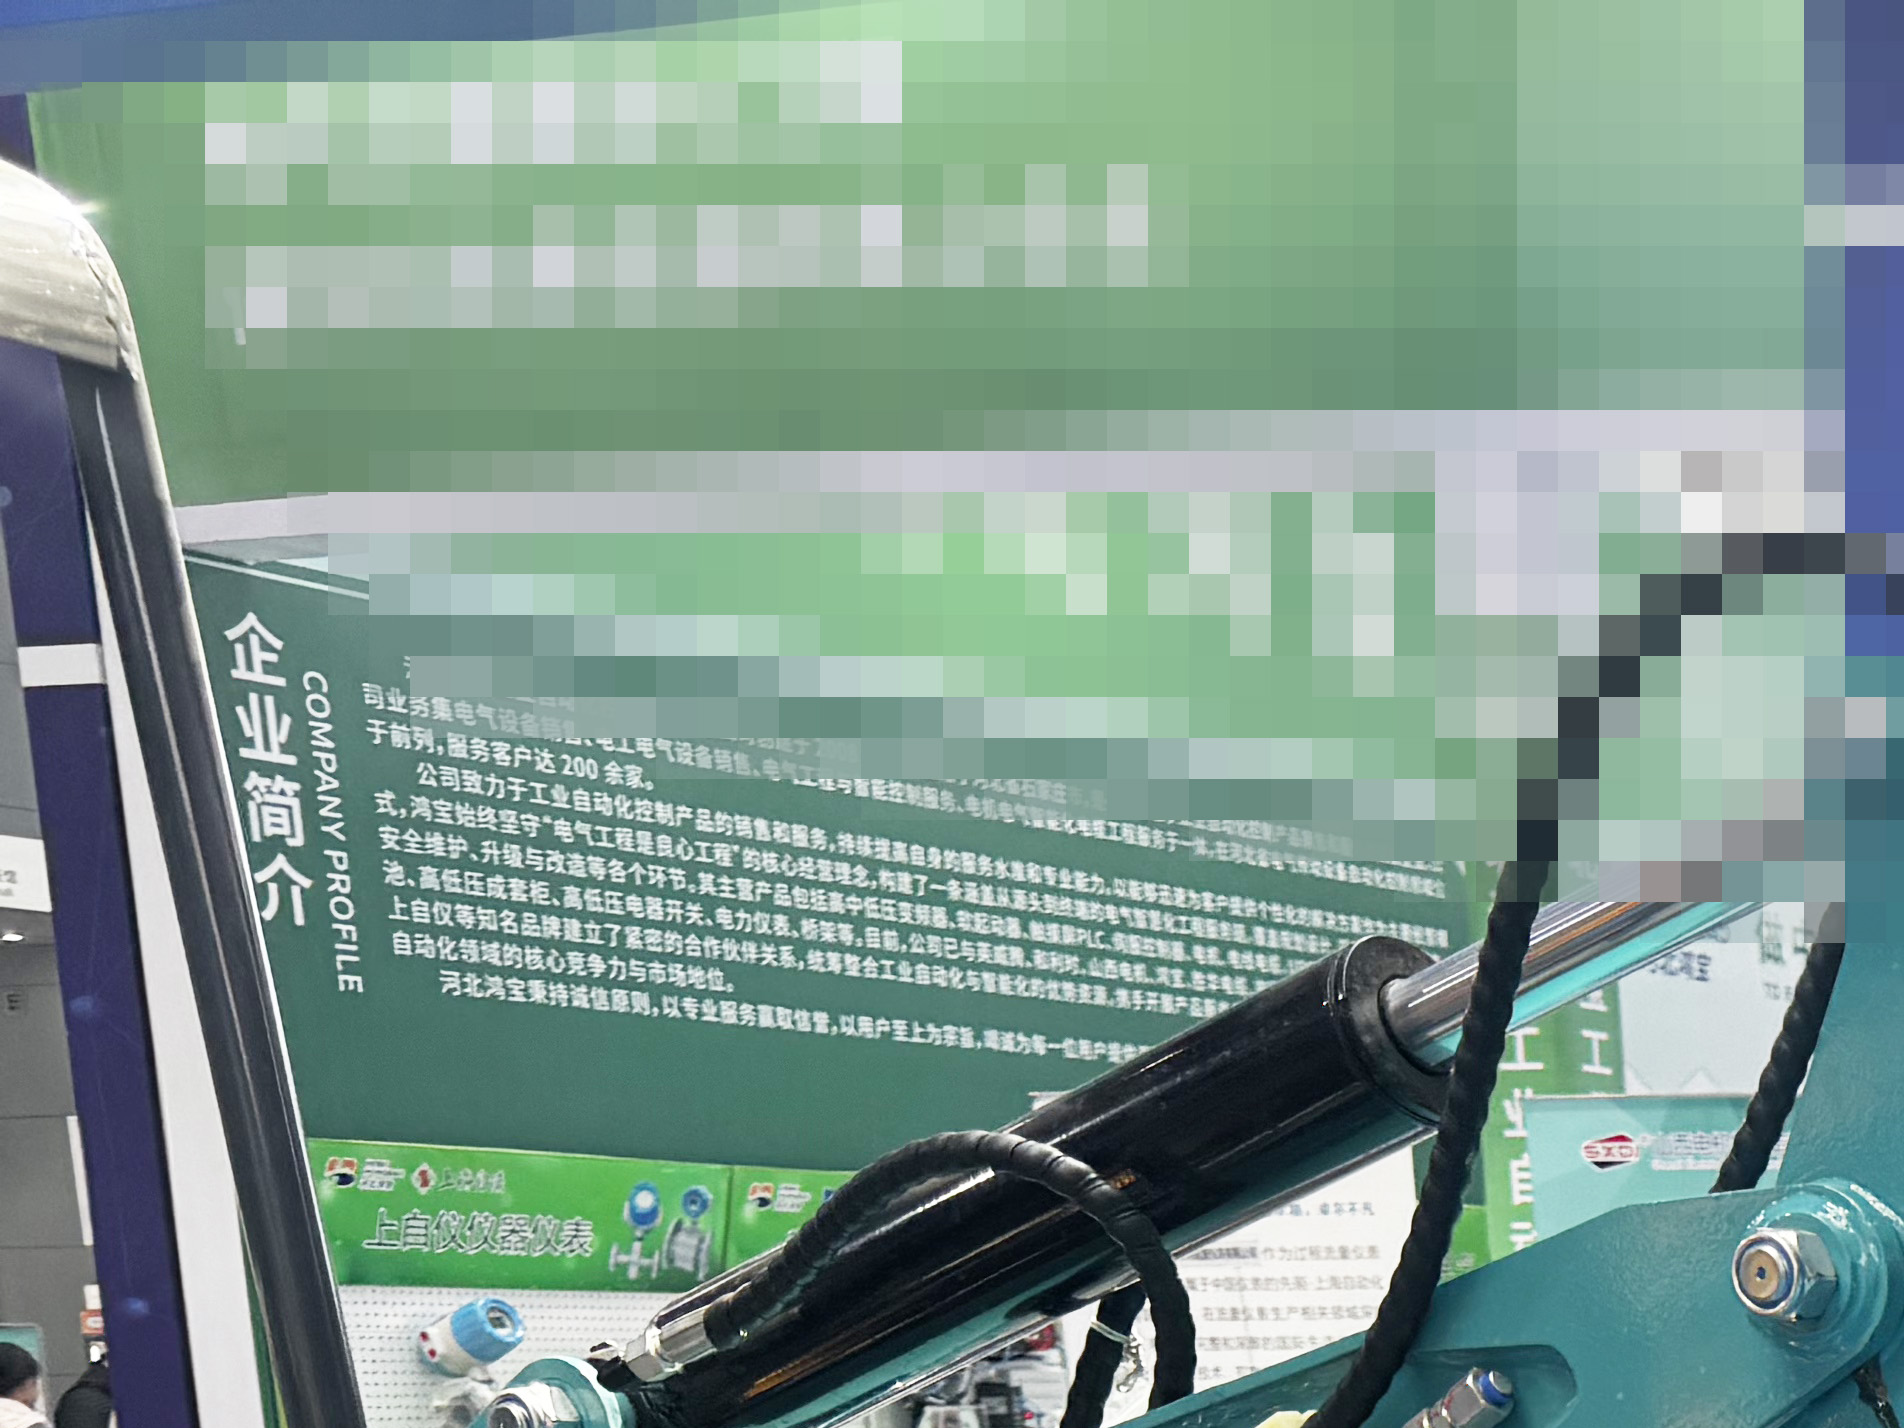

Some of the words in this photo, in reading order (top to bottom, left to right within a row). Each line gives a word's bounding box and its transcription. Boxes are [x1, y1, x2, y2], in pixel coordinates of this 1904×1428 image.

[224, 611, 313, 927] 企业简介
[302, 670, 347, 842] COMPANY
[322, 848, 365, 994] PROFILE
[362, 1207, 595, 1258] 上自仪仪器仪表
